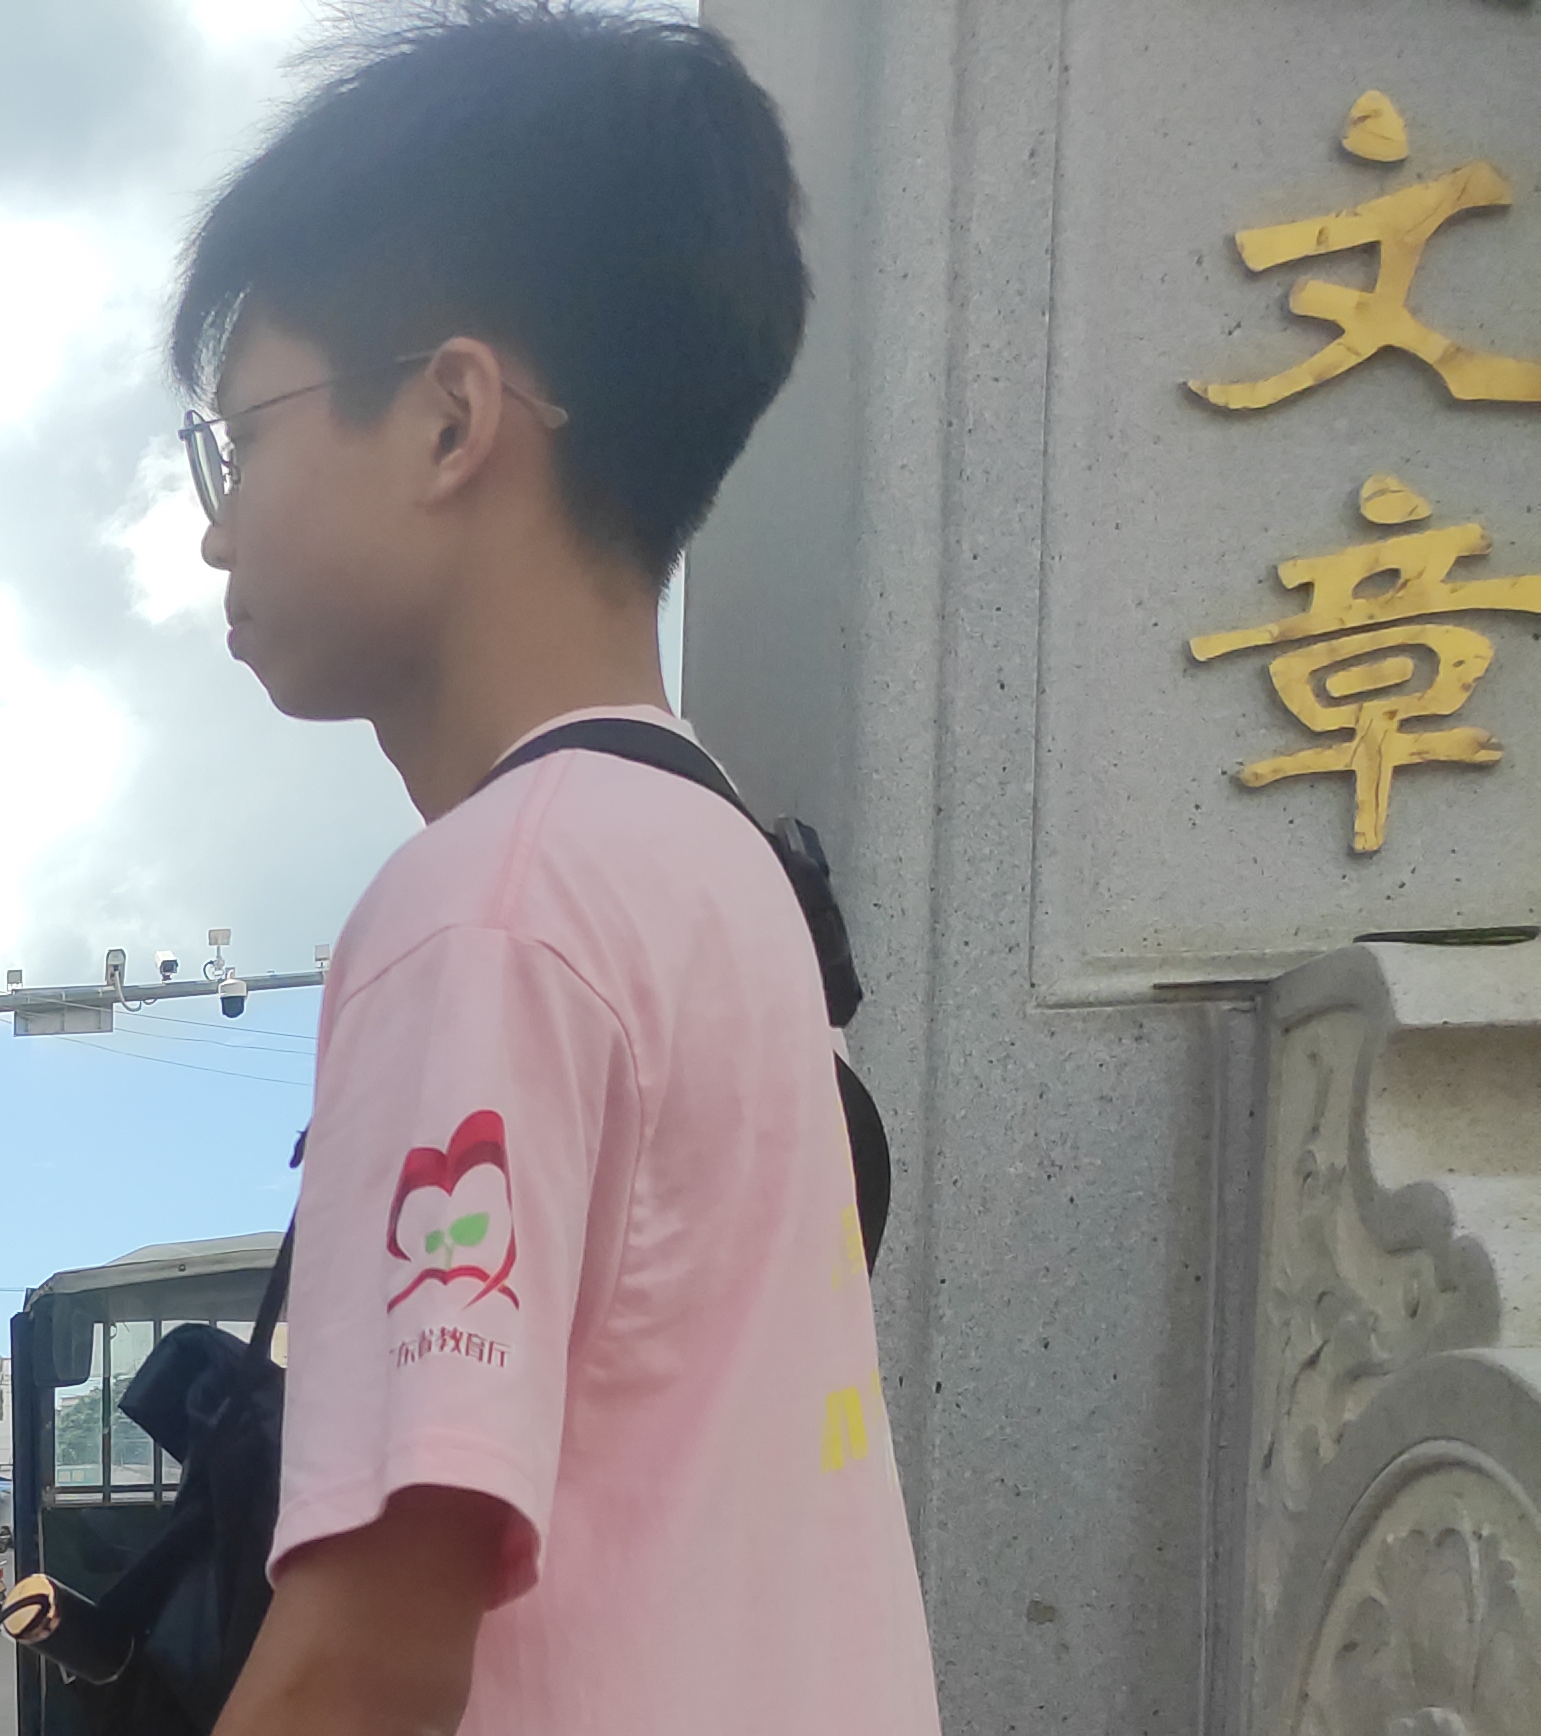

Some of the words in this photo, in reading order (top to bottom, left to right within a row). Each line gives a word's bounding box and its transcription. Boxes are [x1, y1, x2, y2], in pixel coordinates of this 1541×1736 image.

[1184, 88, 1541, 852] 文章
[389, 1326, 512, 1368] 东省教育厅
